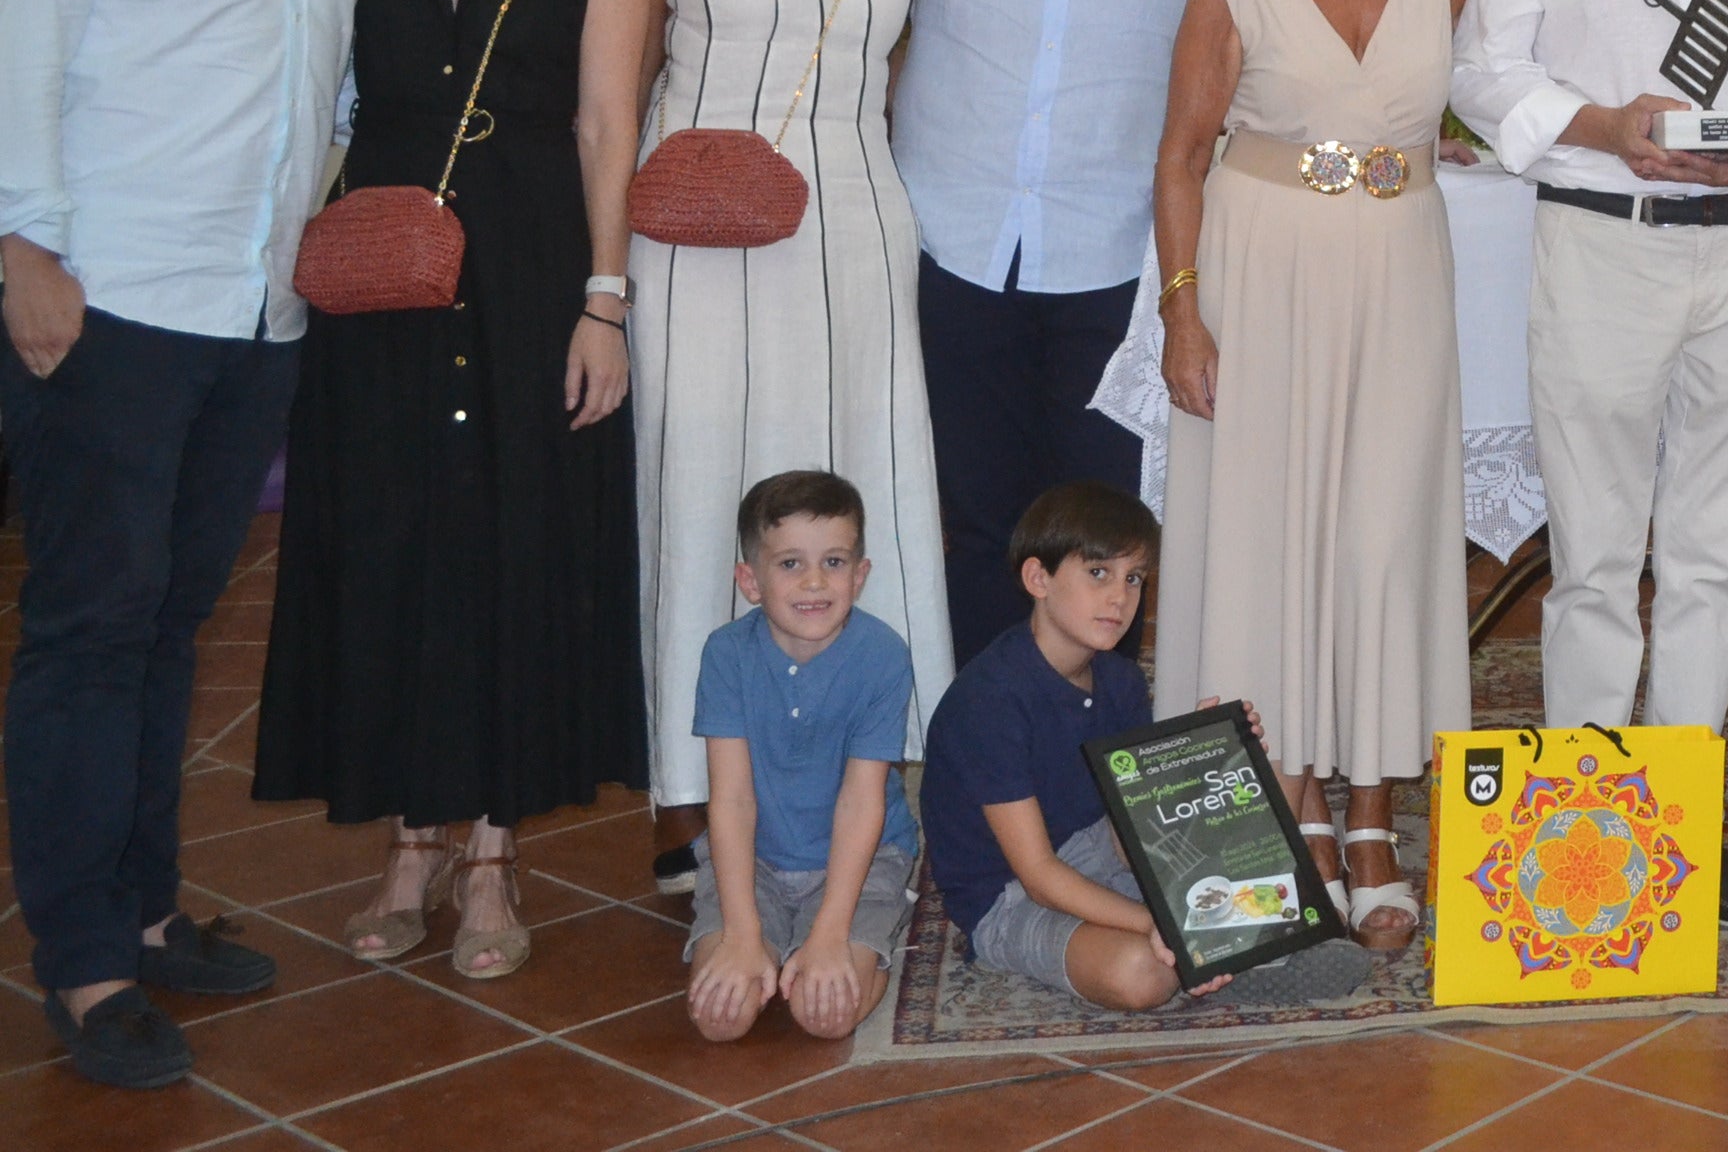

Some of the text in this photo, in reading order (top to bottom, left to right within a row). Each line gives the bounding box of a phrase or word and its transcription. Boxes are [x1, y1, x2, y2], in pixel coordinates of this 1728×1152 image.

[1139, 736, 1192, 756] Asociación
[1143, 736, 1228, 765] Amigos Cocineros
[1146, 747, 1226, 776] de Extremadura
[1203, 765, 1257, 793] San
[1475, 780, 1491, 794] M
[1156, 781, 1262, 825] Lorenzo
